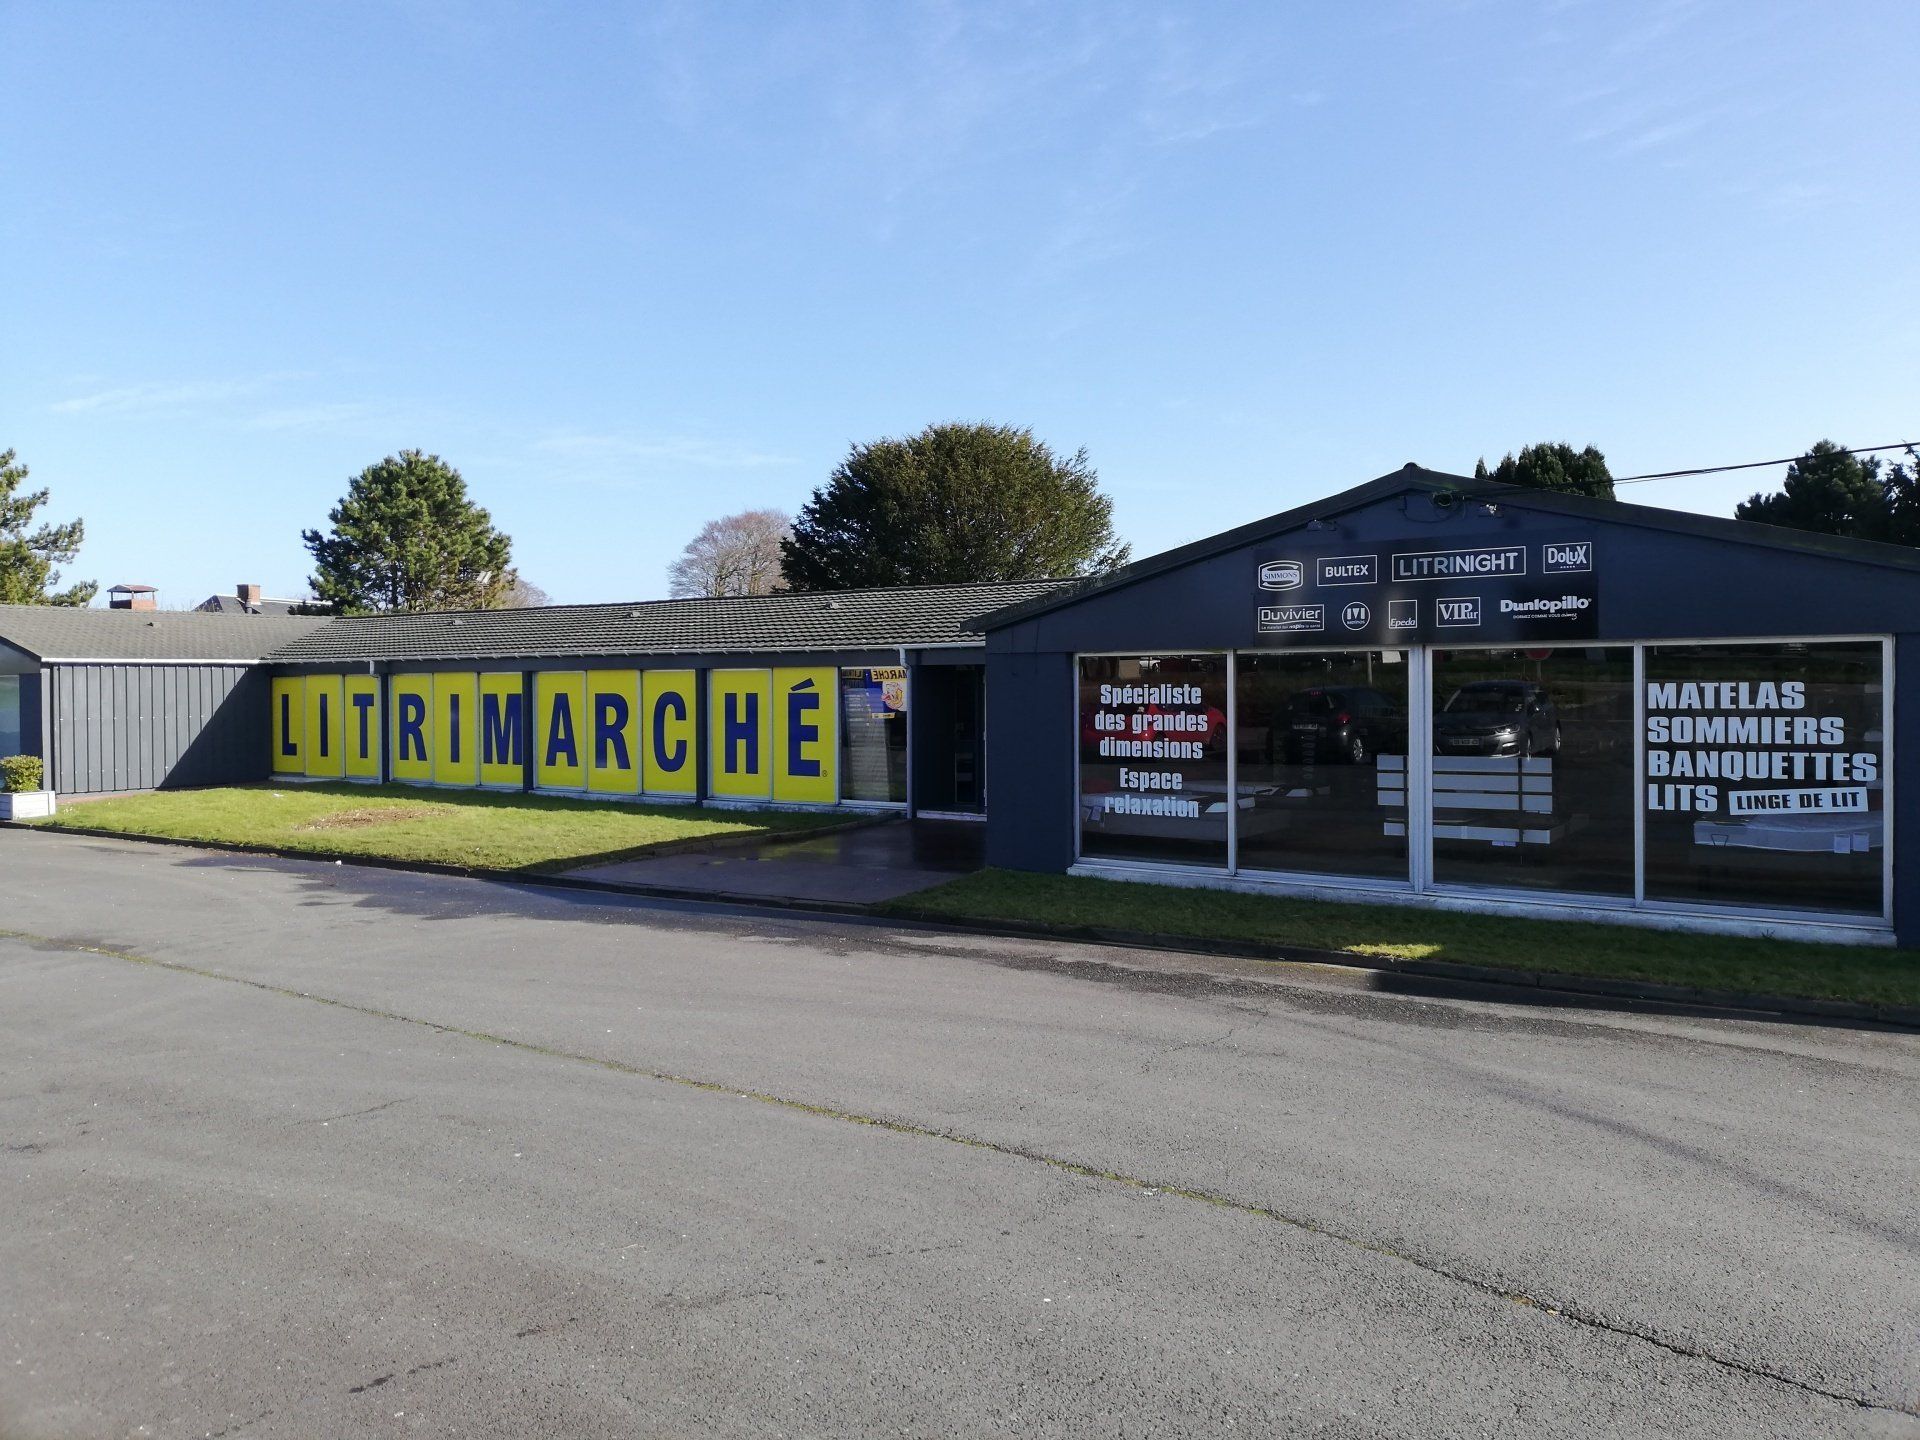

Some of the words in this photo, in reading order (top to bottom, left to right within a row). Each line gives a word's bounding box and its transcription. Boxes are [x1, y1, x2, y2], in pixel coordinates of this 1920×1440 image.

[1264, 571, 1298, 580] SIMMONS
[1325, 564, 1369, 578] BULTEX
[1399, 552, 1518, 576] LITRINIGHT
[1261, 608, 1321, 621] Duvivier
[1500, 595, 1588, 613] Dunlopillo
[1390, 617, 1416, 628] Epeda
[1100, 684, 1202, 707] Spécialiste
[1647, 681, 1805, 709] MATELAS
[1094, 710, 1126, 730] des
[1132, 711, 1208, 734] grandes
[1647, 716, 1845, 745] SOMMIERS
[1100, 737, 1203, 759] dimensions
[1648, 750, 1878, 782] BANQUETTES
[1119, 767, 1183, 791] Espace
[1105, 794, 1199, 818] relaxation
[1648, 783, 1718, 812] LITS
[1736, 794, 1792, 810] LINGE
[1799, 793, 1824, 808] DE
[1831, 792, 1860, 807] LIT
